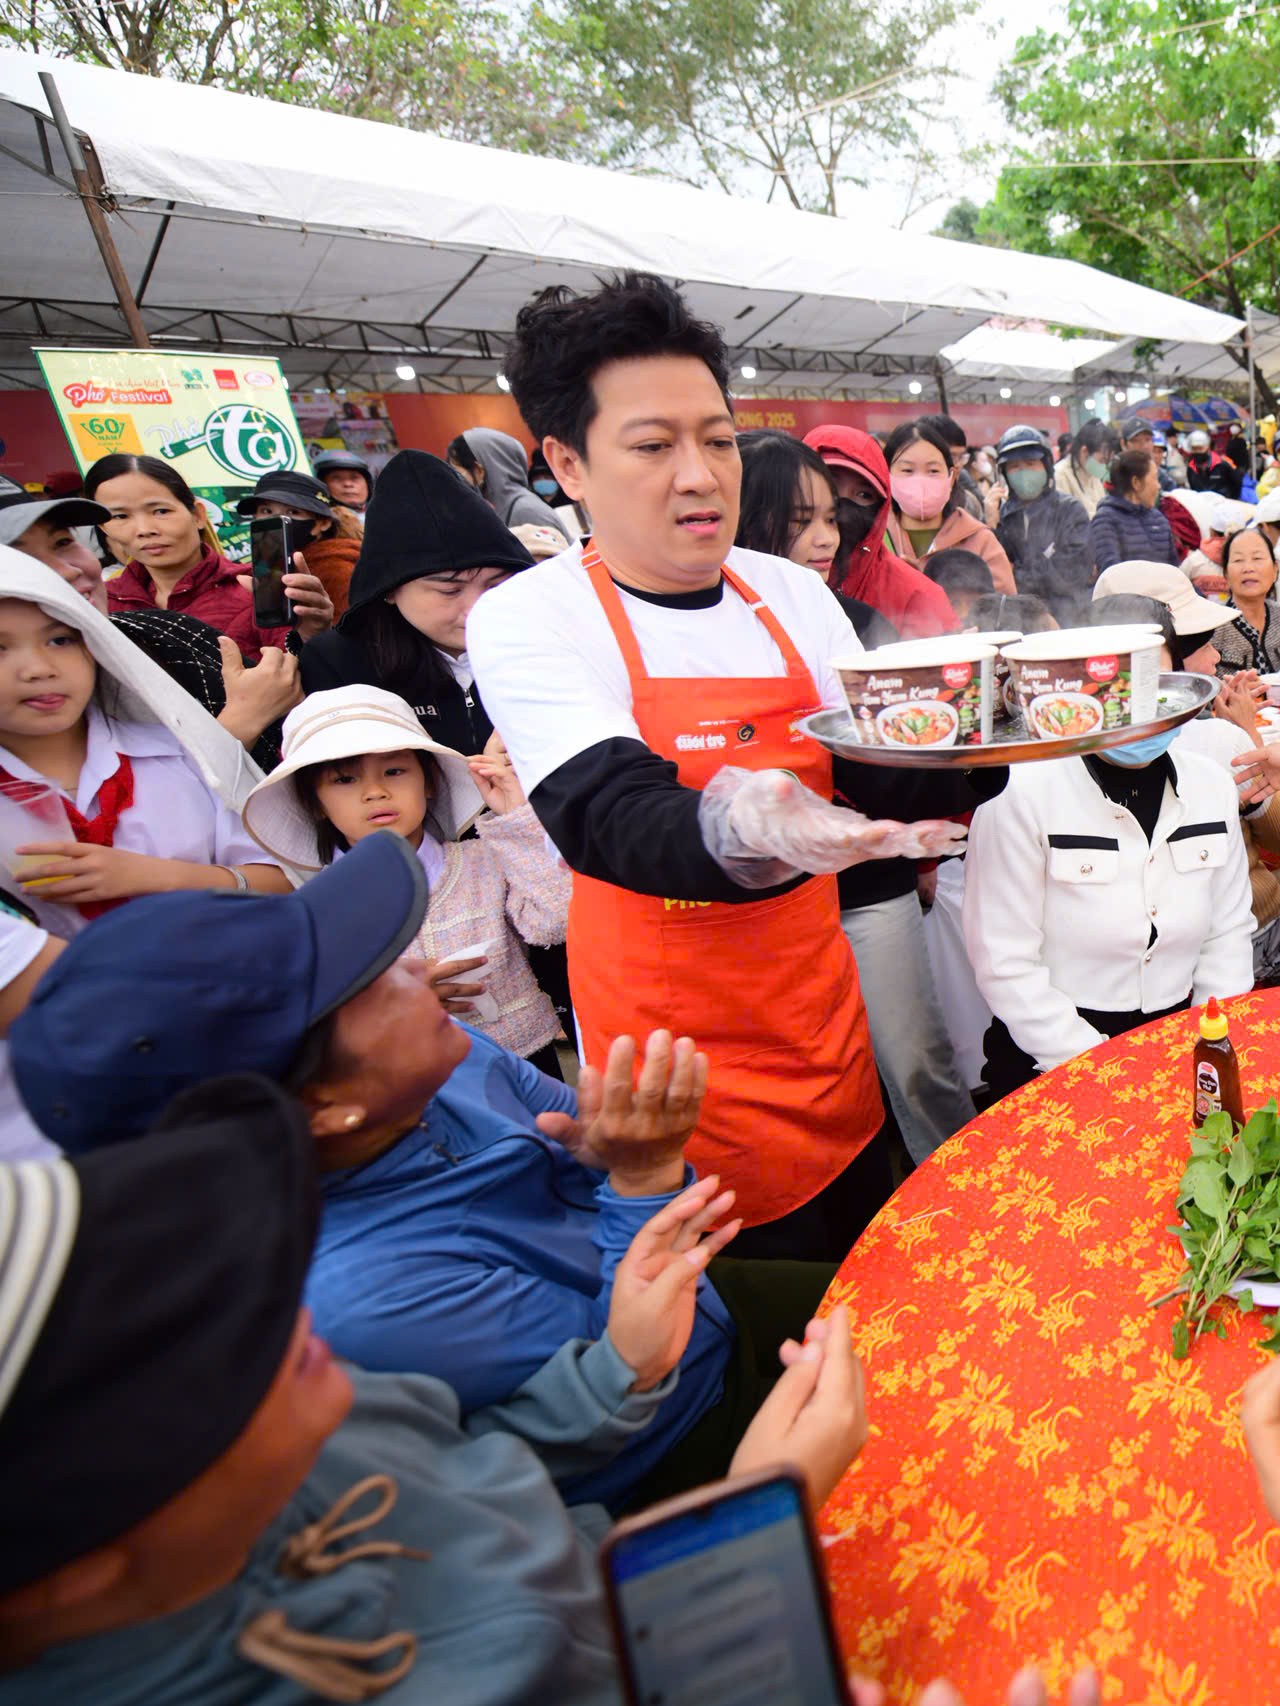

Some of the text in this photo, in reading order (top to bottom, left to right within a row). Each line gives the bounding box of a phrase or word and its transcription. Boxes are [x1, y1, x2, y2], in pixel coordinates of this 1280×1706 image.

[110, 389, 169, 403] Festival
[88, 417, 119, 434] 60
[766, 411, 797, 428] 2025
